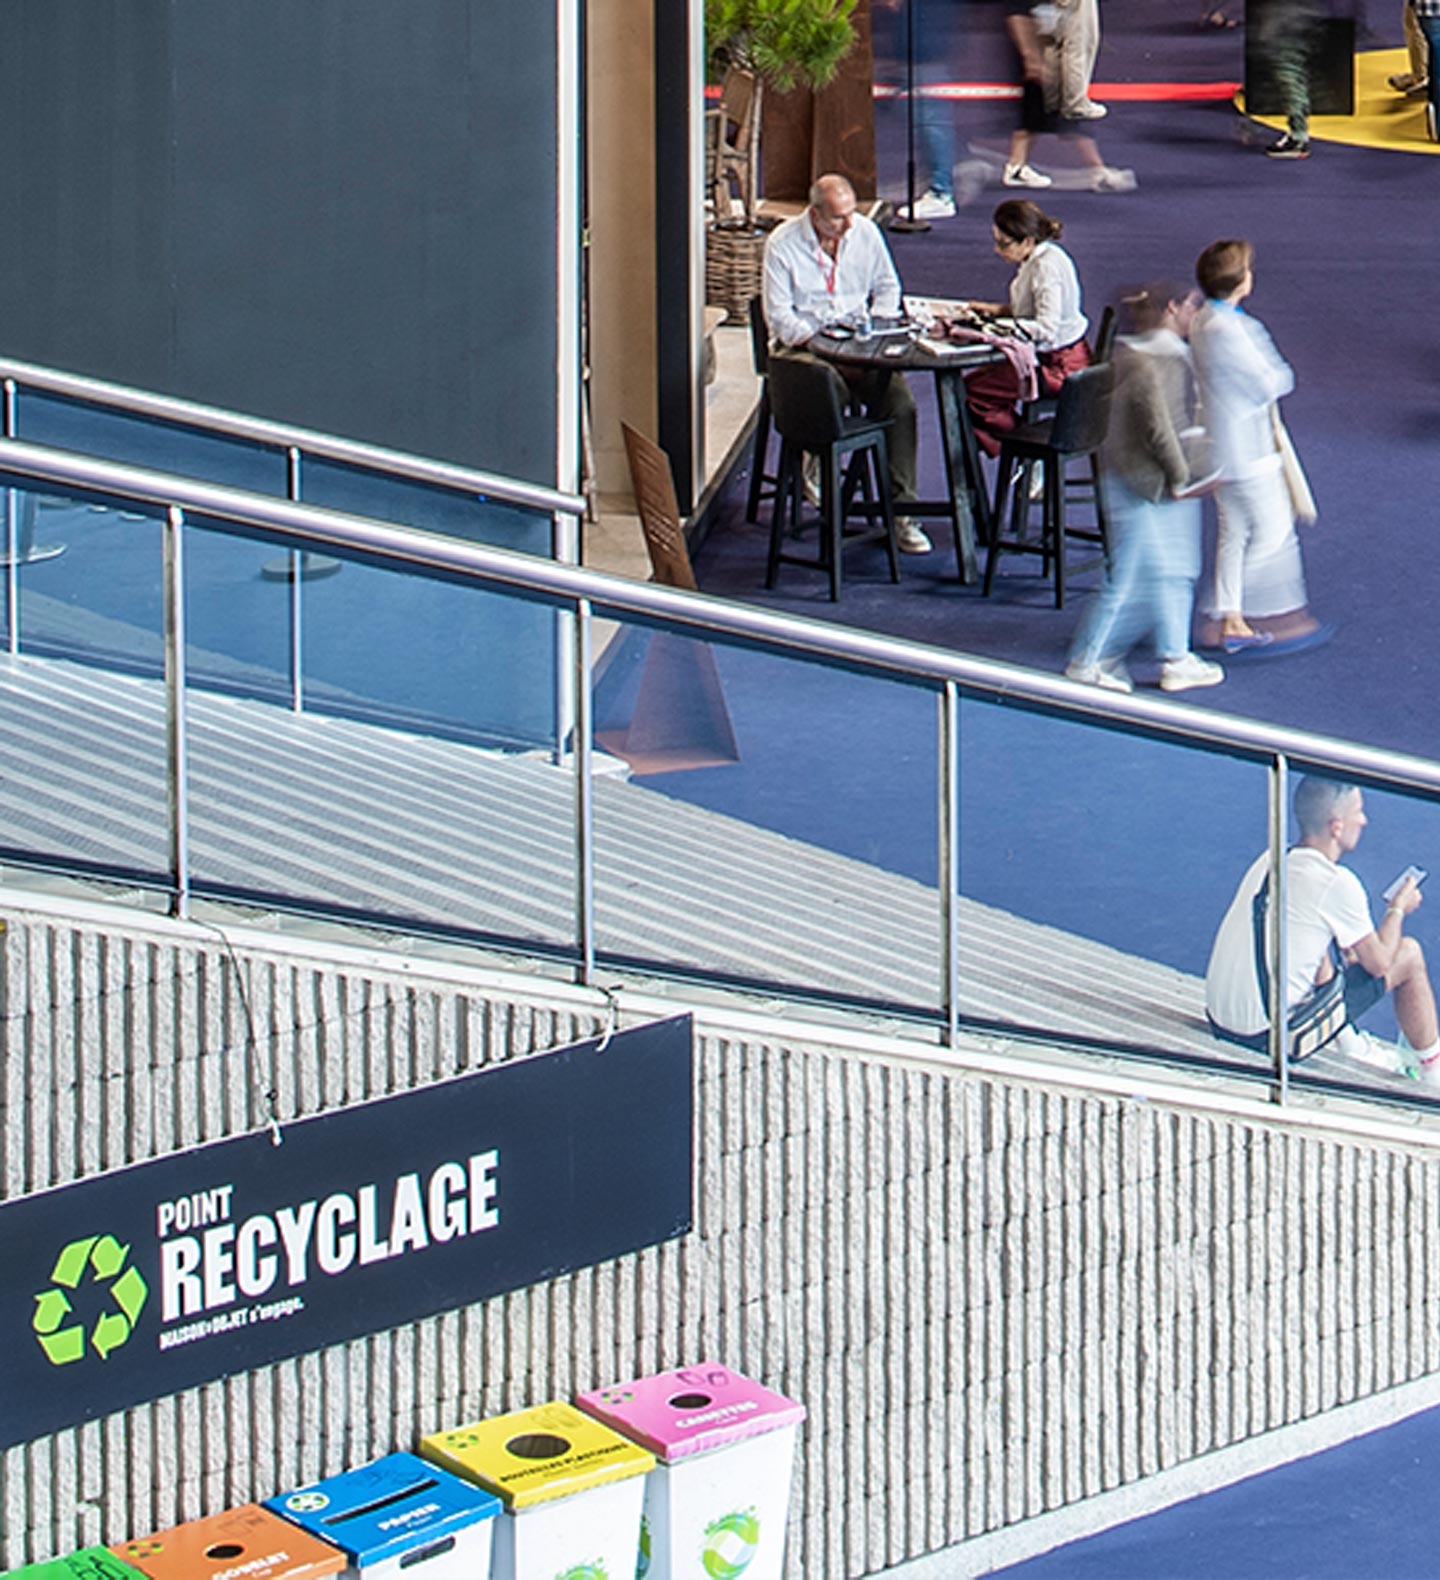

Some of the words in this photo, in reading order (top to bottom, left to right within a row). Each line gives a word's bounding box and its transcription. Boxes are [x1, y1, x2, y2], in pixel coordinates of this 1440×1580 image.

[158, 1185, 233, 1238] POINT
[160, 1149, 500, 1323] RECYCLAGE
[377, 1503, 441, 1531] PAPIER
[212, 1551, 290, 1580] GOBELET
